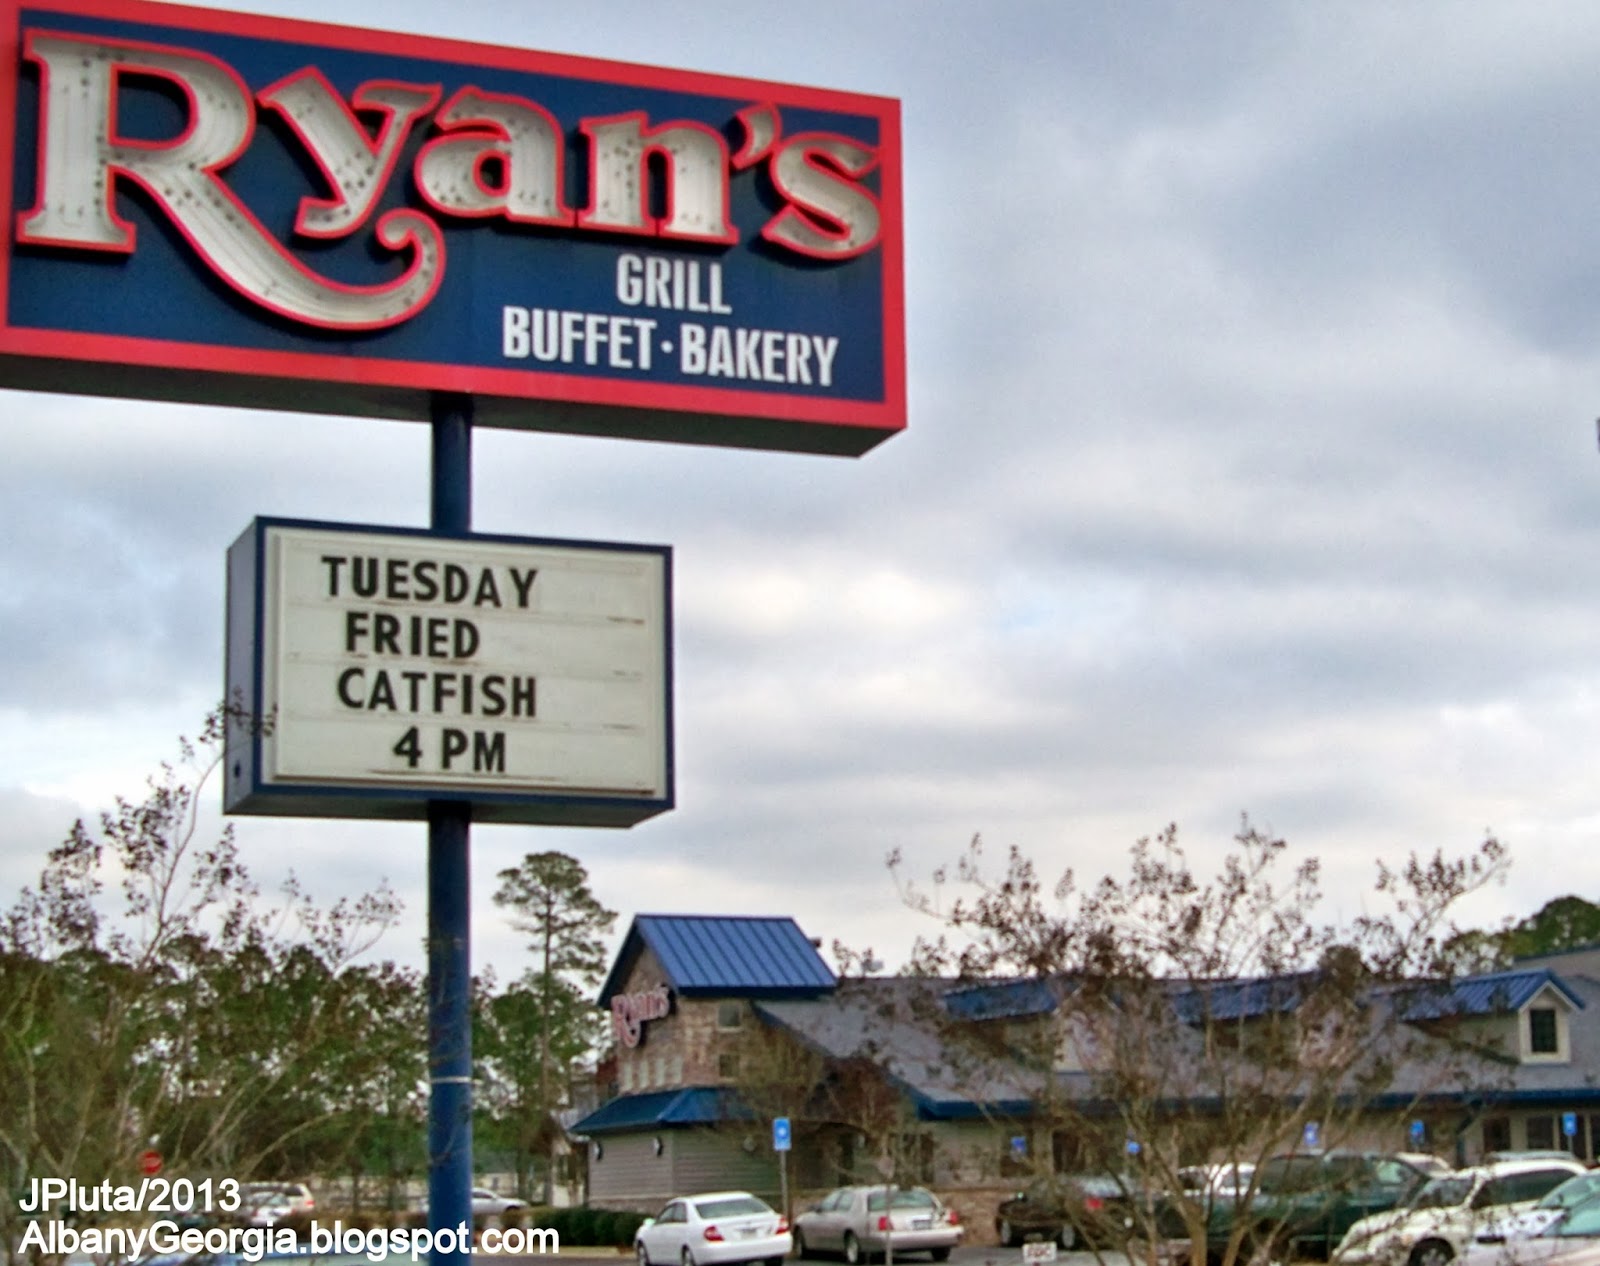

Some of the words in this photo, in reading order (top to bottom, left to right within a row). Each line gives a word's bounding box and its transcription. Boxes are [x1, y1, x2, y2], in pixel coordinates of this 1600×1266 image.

[15, 28, 882, 331] Ryan's
[616, 253, 732, 315] GRILL
[502, 305, 657, 370] BUFFET
[680, 322, 838, 387] BAKERY
[322, 555, 538, 608] TUESDAY
[345, 611, 480, 659] FRIED
[337, 667, 536, 718] CATFISH
[392, 726, 423, 768] 4
[441, 729, 506, 773] PM
